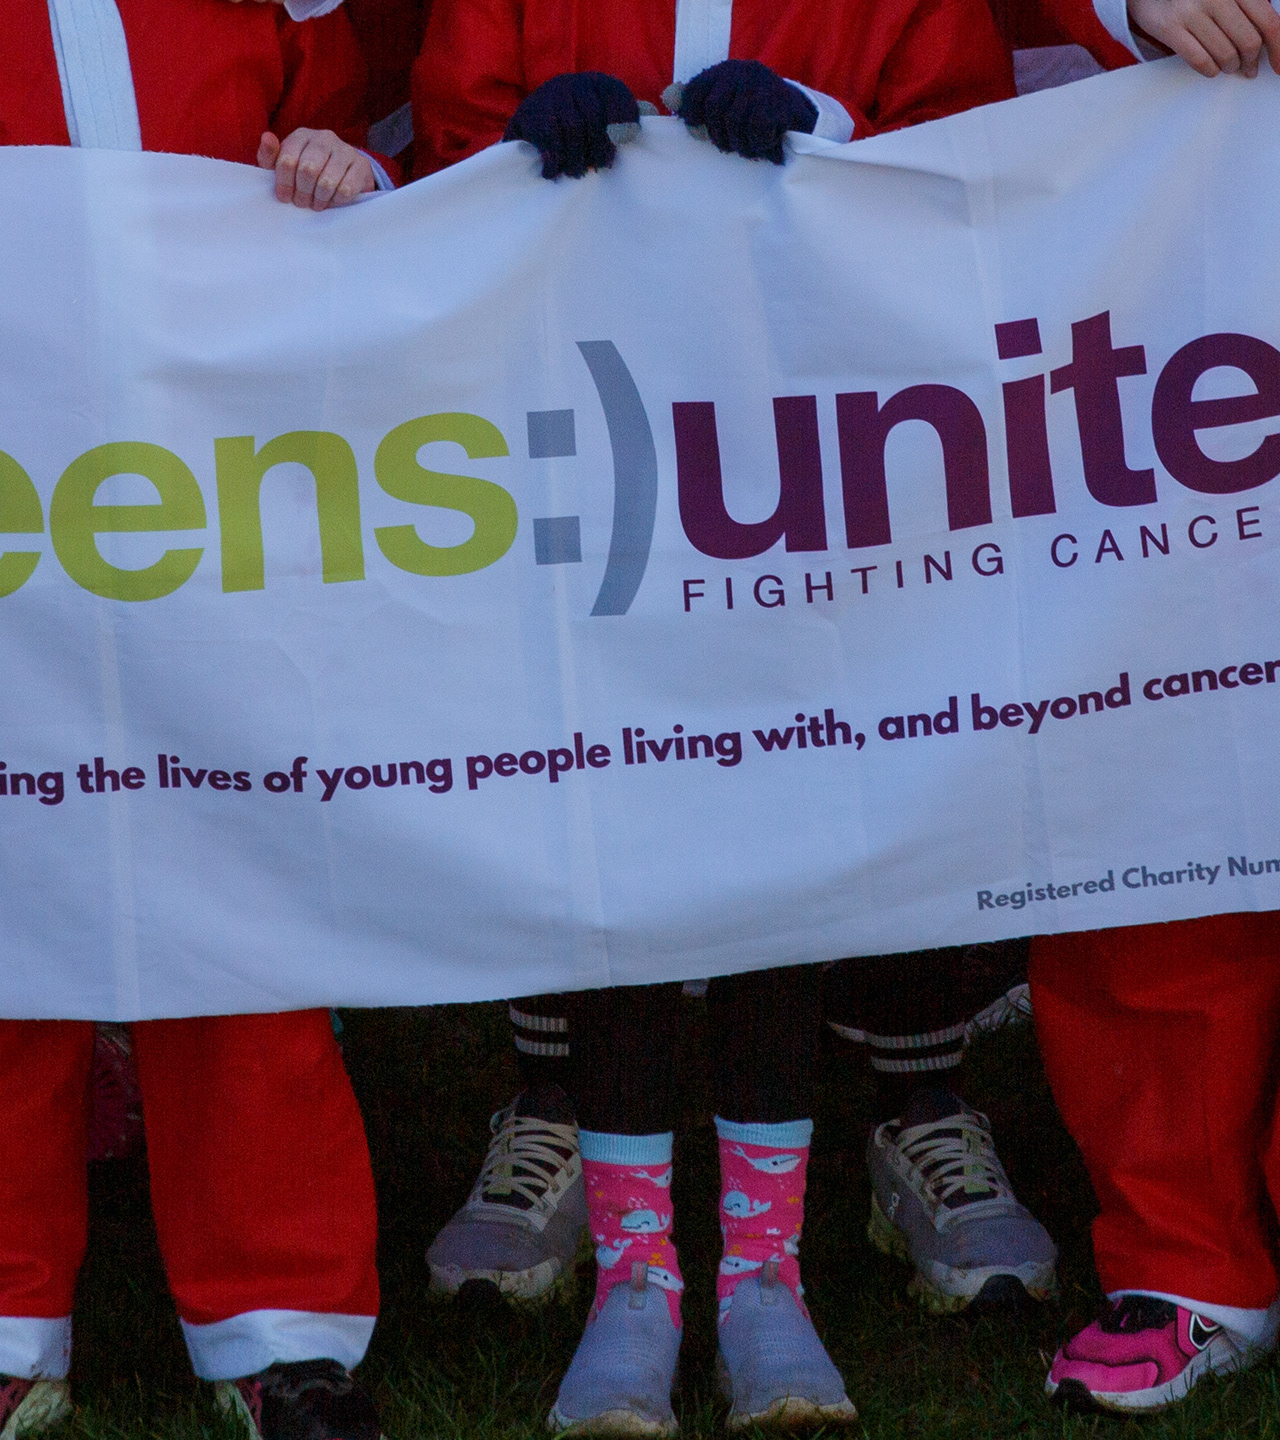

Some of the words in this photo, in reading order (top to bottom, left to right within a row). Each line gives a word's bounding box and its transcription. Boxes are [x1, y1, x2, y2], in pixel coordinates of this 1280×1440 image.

[683, 543, 1005, 612] FIGHTING
[76, 757, 146, 793] the
[157, 754, 253, 792] lives
[263, 755, 309, 793] of
[316, 758, 454, 803] young
[466, 732, 612, 791] people
[621, 724, 743, 768] living
[753, 708, 867, 753] with,
[877, 696, 960, 742] and
[971, 672, 1132, 735] beyond
[976, 870, 1115, 911] Registered
[1121, 862, 1221, 891] Charity
